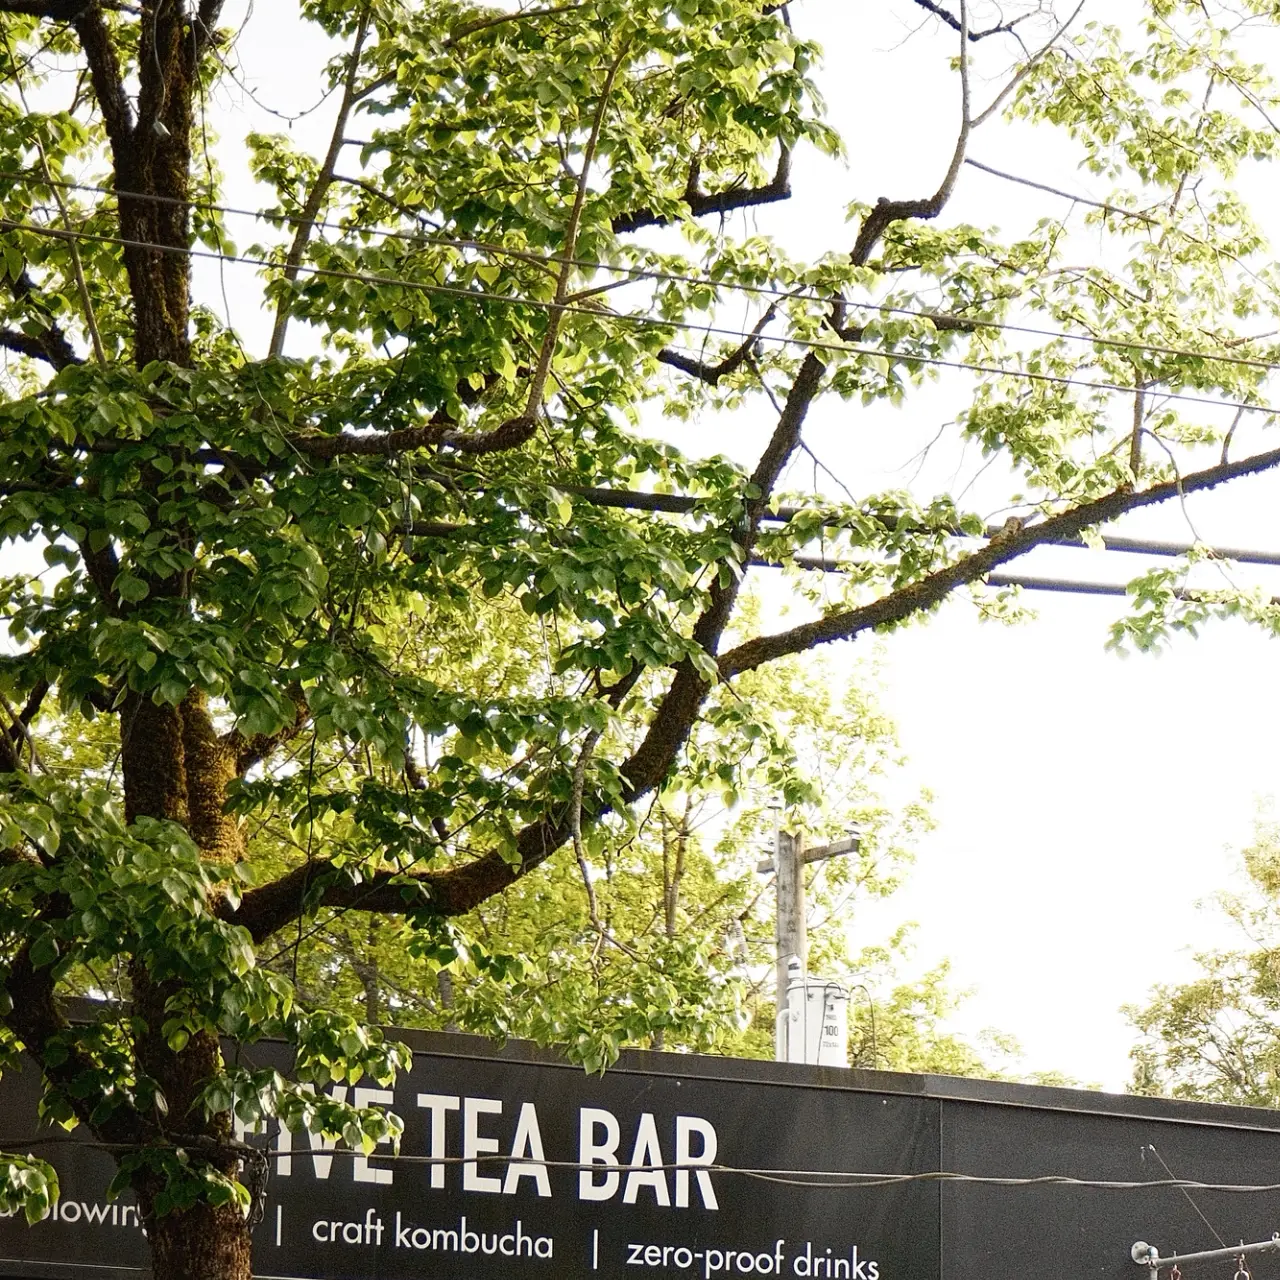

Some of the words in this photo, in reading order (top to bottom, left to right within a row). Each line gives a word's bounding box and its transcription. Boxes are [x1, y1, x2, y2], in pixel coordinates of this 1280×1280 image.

[824, 1025, 839, 1037] 100
[417, 1093, 552, 1197] TEA
[579, 1107, 719, 1210] BAR
[311, 1208, 384, 1246] craft
[395, 1211, 554, 1259] kombucha
[626, 1240, 786, 1280] zero-proof
